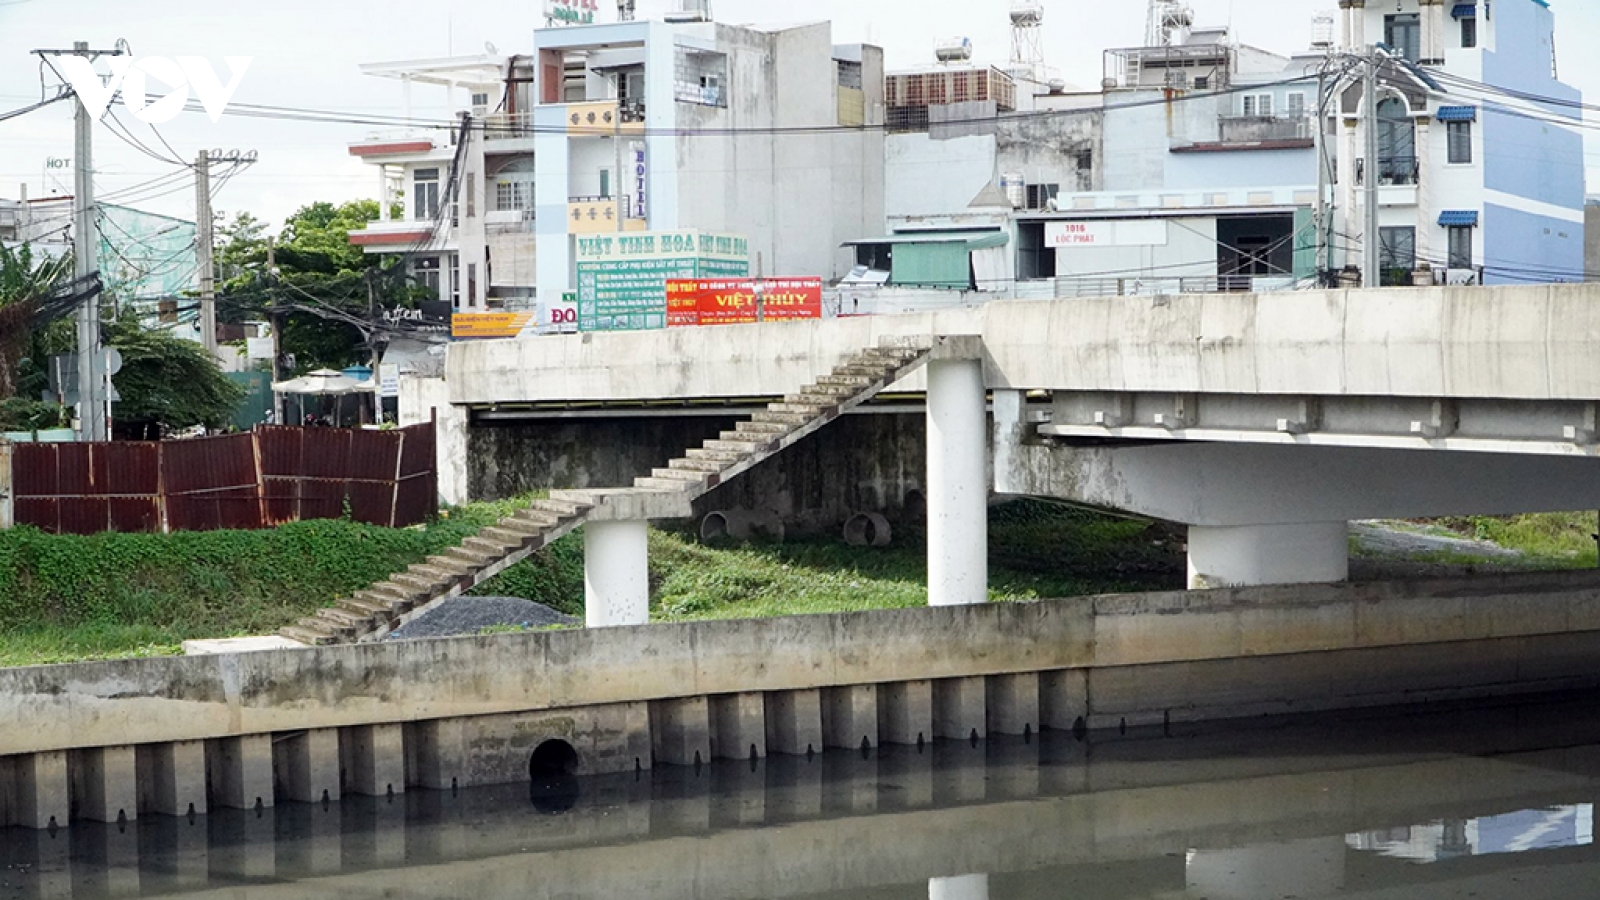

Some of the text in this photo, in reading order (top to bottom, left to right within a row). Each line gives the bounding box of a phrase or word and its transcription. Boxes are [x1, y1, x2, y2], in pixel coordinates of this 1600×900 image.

[46, 157, 72, 169] HOT
[636, 150, 645, 216] HOTEL
[1065, 224, 1086, 233] 1016
[578, 233, 696, 259] VIỆT TINH HOA
[715, 291, 755, 309] VIỆT
